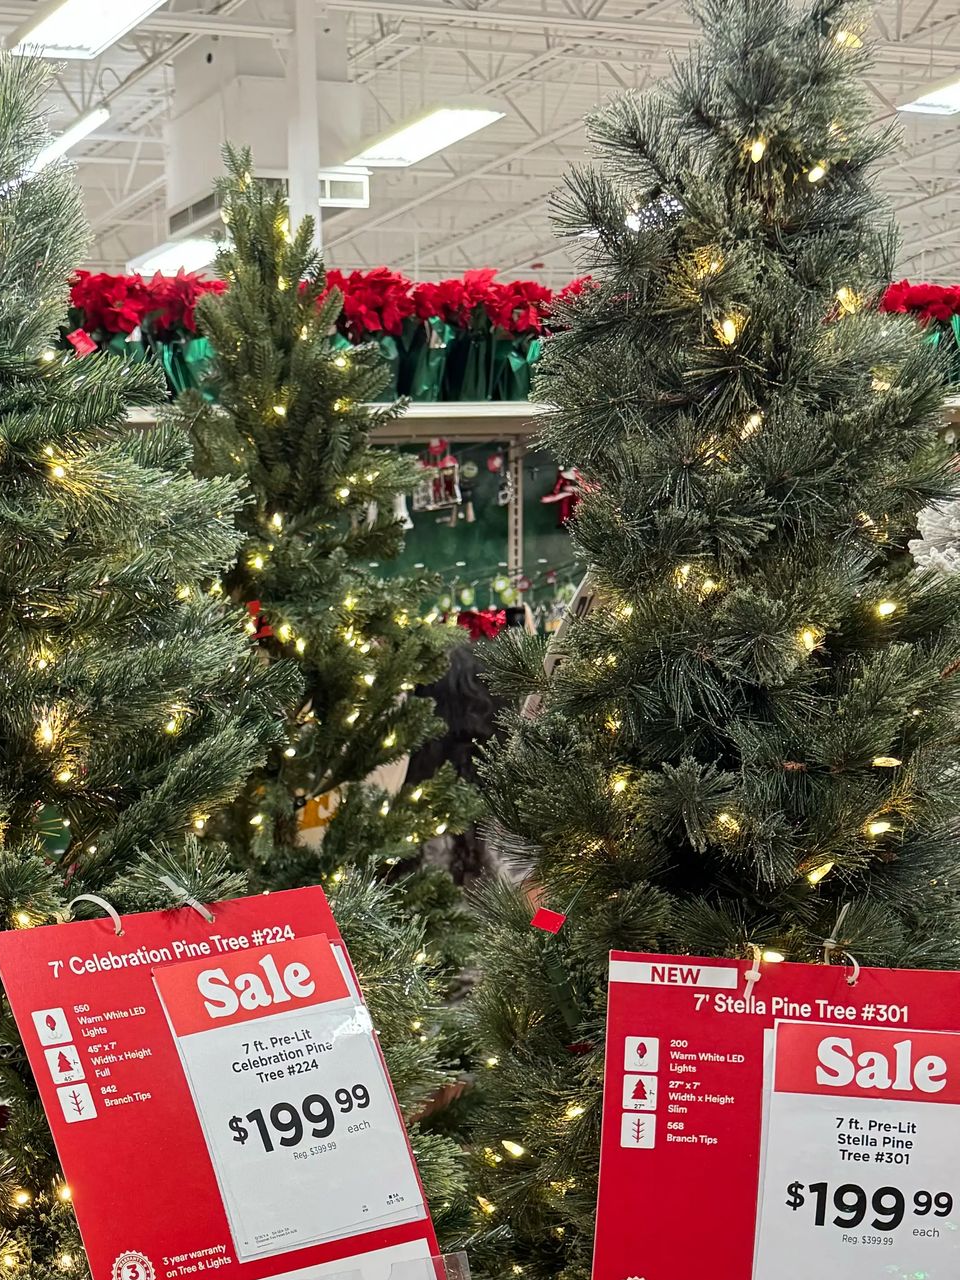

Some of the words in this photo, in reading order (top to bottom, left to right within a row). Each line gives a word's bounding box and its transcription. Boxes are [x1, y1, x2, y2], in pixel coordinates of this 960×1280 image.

[69, 947, 172, 974] Celebration
[172, 940, 211, 958] Pine
[209, 935, 249, 952] Tree
[251, 925, 295, 946] #224
[651, 966, 701, 985] NEW
[196, 953, 316, 1019] Sale
[74, 1004, 90, 1013] 550
[77, 1016, 103, 1025] Warm
[103, 1010, 129, 1020] White
[129, 1006, 146, 1016] LED
[714, 994, 766, 1015] Stella
[772, 997, 812, 1017] Pine
[815, 1000, 857, 1020] Tree
[861, 1004, 908, 1023] #301
[81, 1027, 108, 1038] Lights
[242, 1043, 249, 1055] 7
[254, 1041, 268, 1052] ft.
[270, 1029, 312, 1048] Pre-Lit
[232, 1049, 304, 1073] Celebration
[815, 1036, 948, 1093] Sale
[256, 1070, 285, 1083] Tree
[287, 1059, 319, 1076] #224
[347, 1120, 371, 1134] each
[667, 1122, 684, 1130] 568
[836, 1117, 844, 1129] 7
[849, 1118, 863, 1130] ft.
[869, 1120, 917, 1134] Pre-Lit
[667, 1133, 698, 1143] Branch
[699, 1135, 718, 1145] Tips
[838, 1133, 877, 1147] Stella
[883, 1136, 913, 1149] Pine
[309, 1141, 337, 1156] $399.99
[839, 1149, 870, 1162] Tree
[875, 1152, 909, 1165] #301
[842, 1234, 859, 1245] Reg.
[862, 1235, 893, 1246] $399.99
[913, 1228, 940, 1238] each
[162, 1257, 169, 1266] 3
[169, 1254, 188, 1266] year
[189, 1245, 226, 1259] warranty
[166, 1270, 178, 1278] on
[177, 1265, 197, 1275] Tree
[198, 1261, 206, 1271] &
[206, 1256, 232, 1269] Lights
